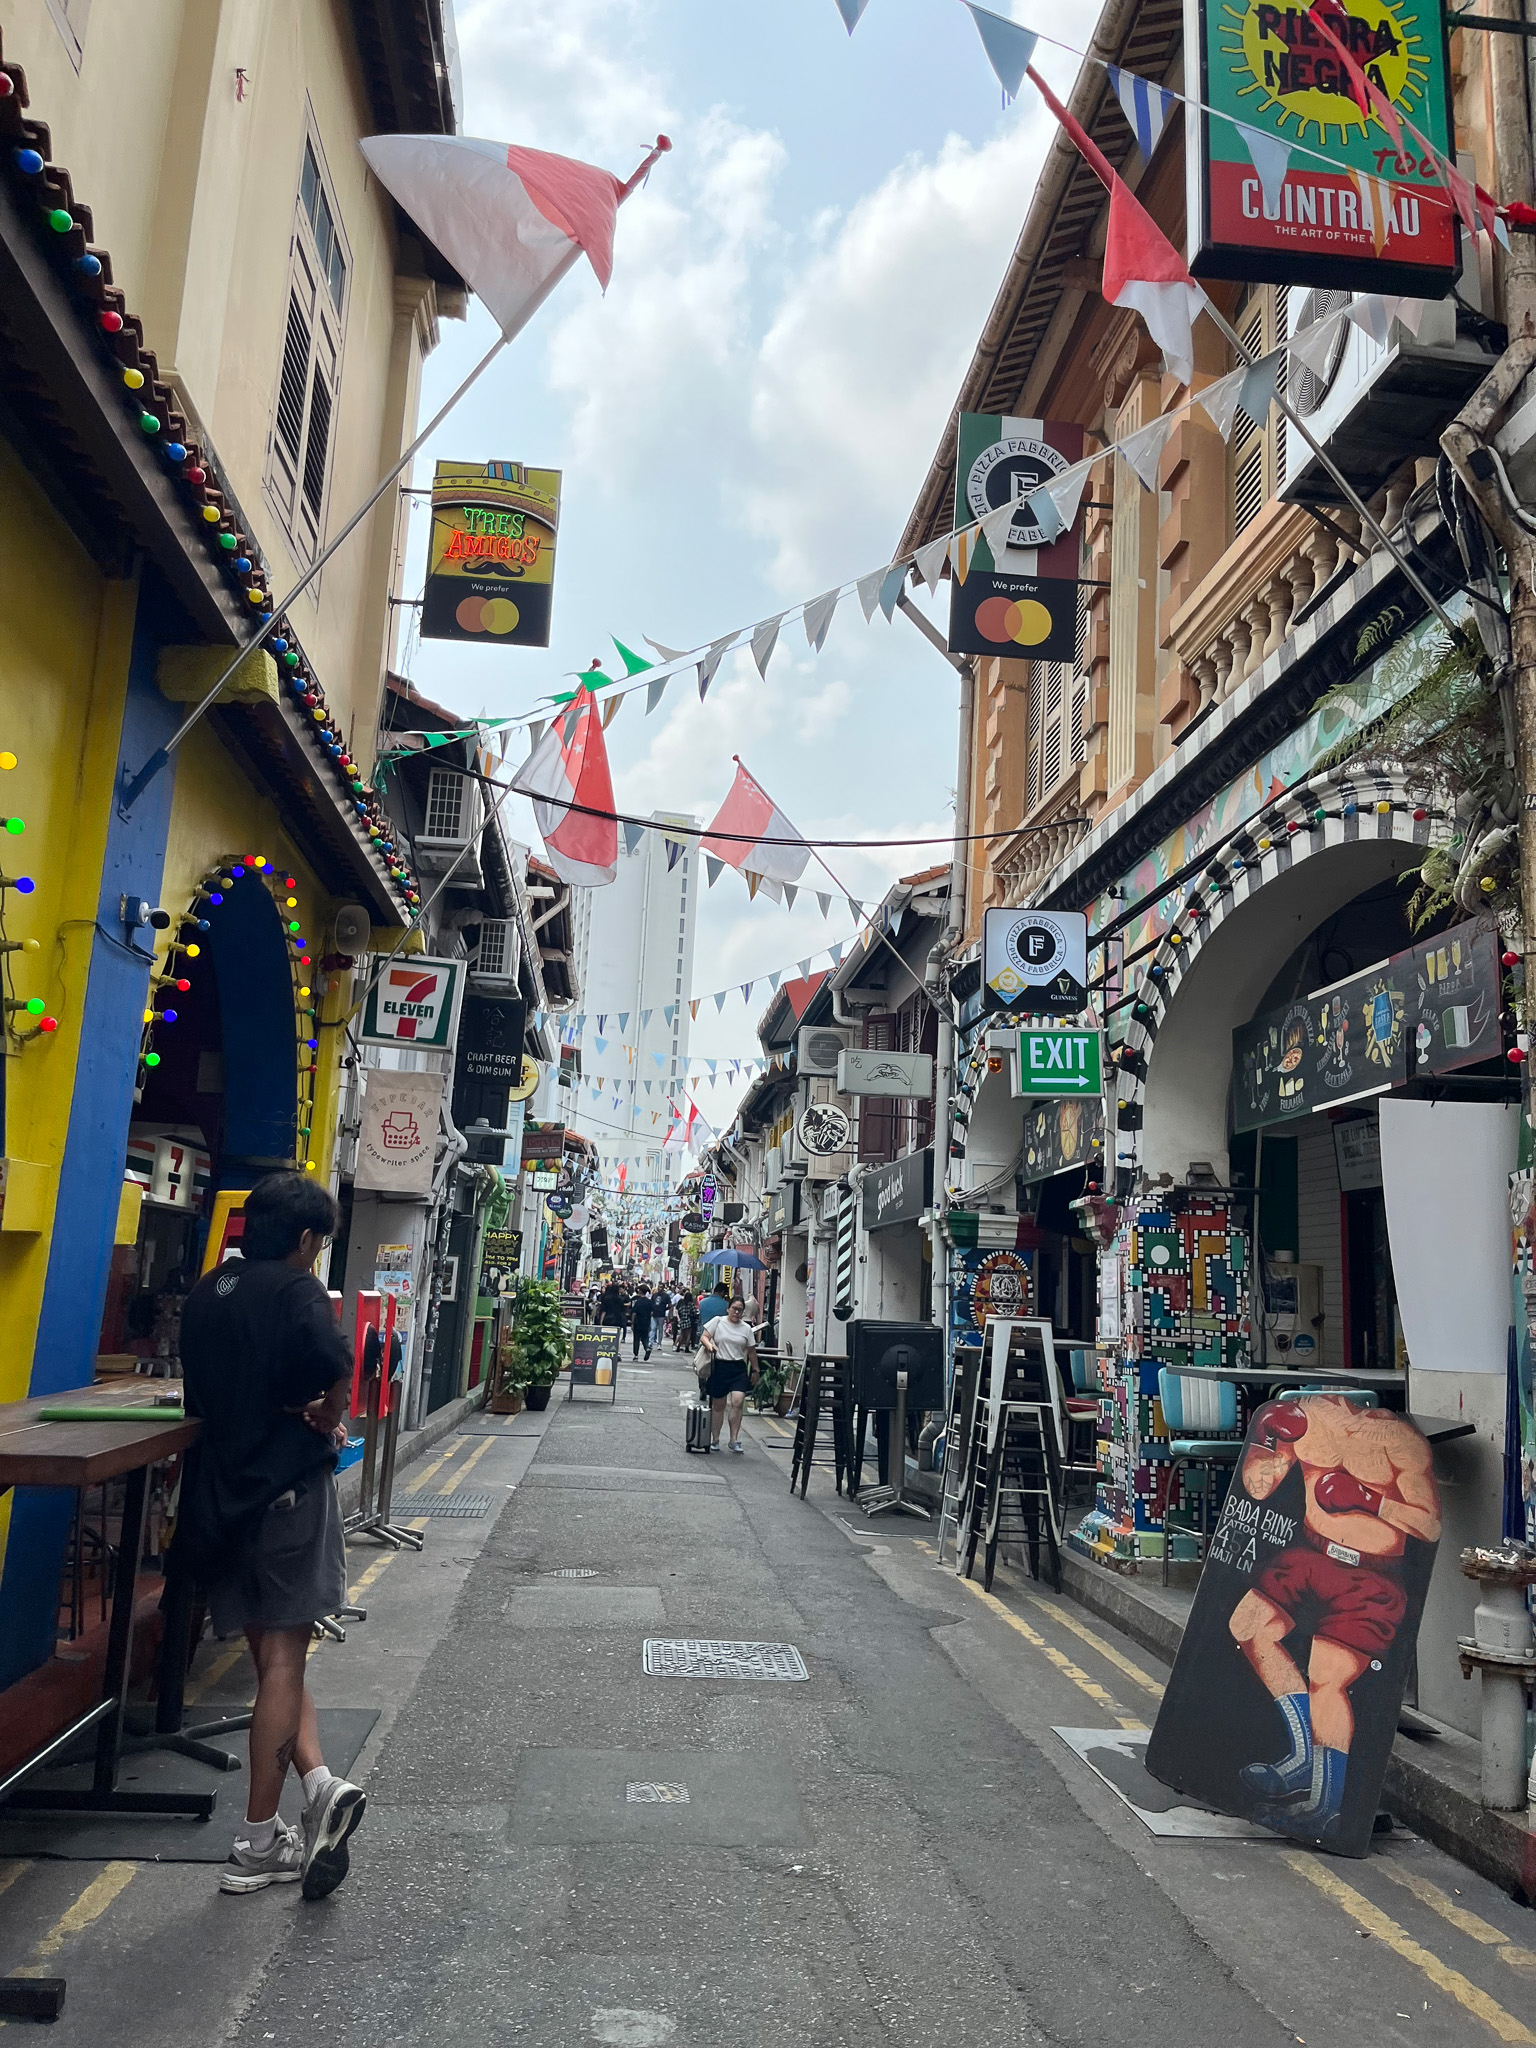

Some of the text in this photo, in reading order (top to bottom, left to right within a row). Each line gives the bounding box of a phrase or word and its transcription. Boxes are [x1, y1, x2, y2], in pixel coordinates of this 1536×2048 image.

[1256, 4, 1399, 56] PIEDRA
[1275, 225, 1298, 236] THE
[1300, 227, 1323, 238] ART
[1326, 229, 1341, 240] OF
[1343, 232, 1366, 243] THE
[971, 446, 1006, 484] PIZZA
[463, 506, 526, 538] TRES
[444, 529, 541, 564] AMIGOS
[485, 584, 510, 593] prefer
[992, 580, 1039, 592] We prefer
[1009, 918, 1062, 944] PIZZA FABBRICA
[1028, 935, 1045, 957] F
[1009, 947, 1064, 974] PIZZA FABBRICA
[389, 969, 438, 1038] 7
[1050, 993, 1078, 1001] GUINNESS
[467, 1051, 517, 1065] CRAFT BEER
[1029, 1037, 1089, 1069] EXIT
[466, 1063, 474, 1073] &
[475, 1064, 492, 1075] DIM
[366, 1143, 430, 1167] typewriter space
[576, 1333, 616, 1343] DRAFT
[574, 1358, 593, 1366] $12
[1222, 1514, 1287, 1547] TATTOO FIRM
[1225, 1495, 1298, 1542] BADA BINK
[1210, 1545, 1254, 1573] HAJI LN
